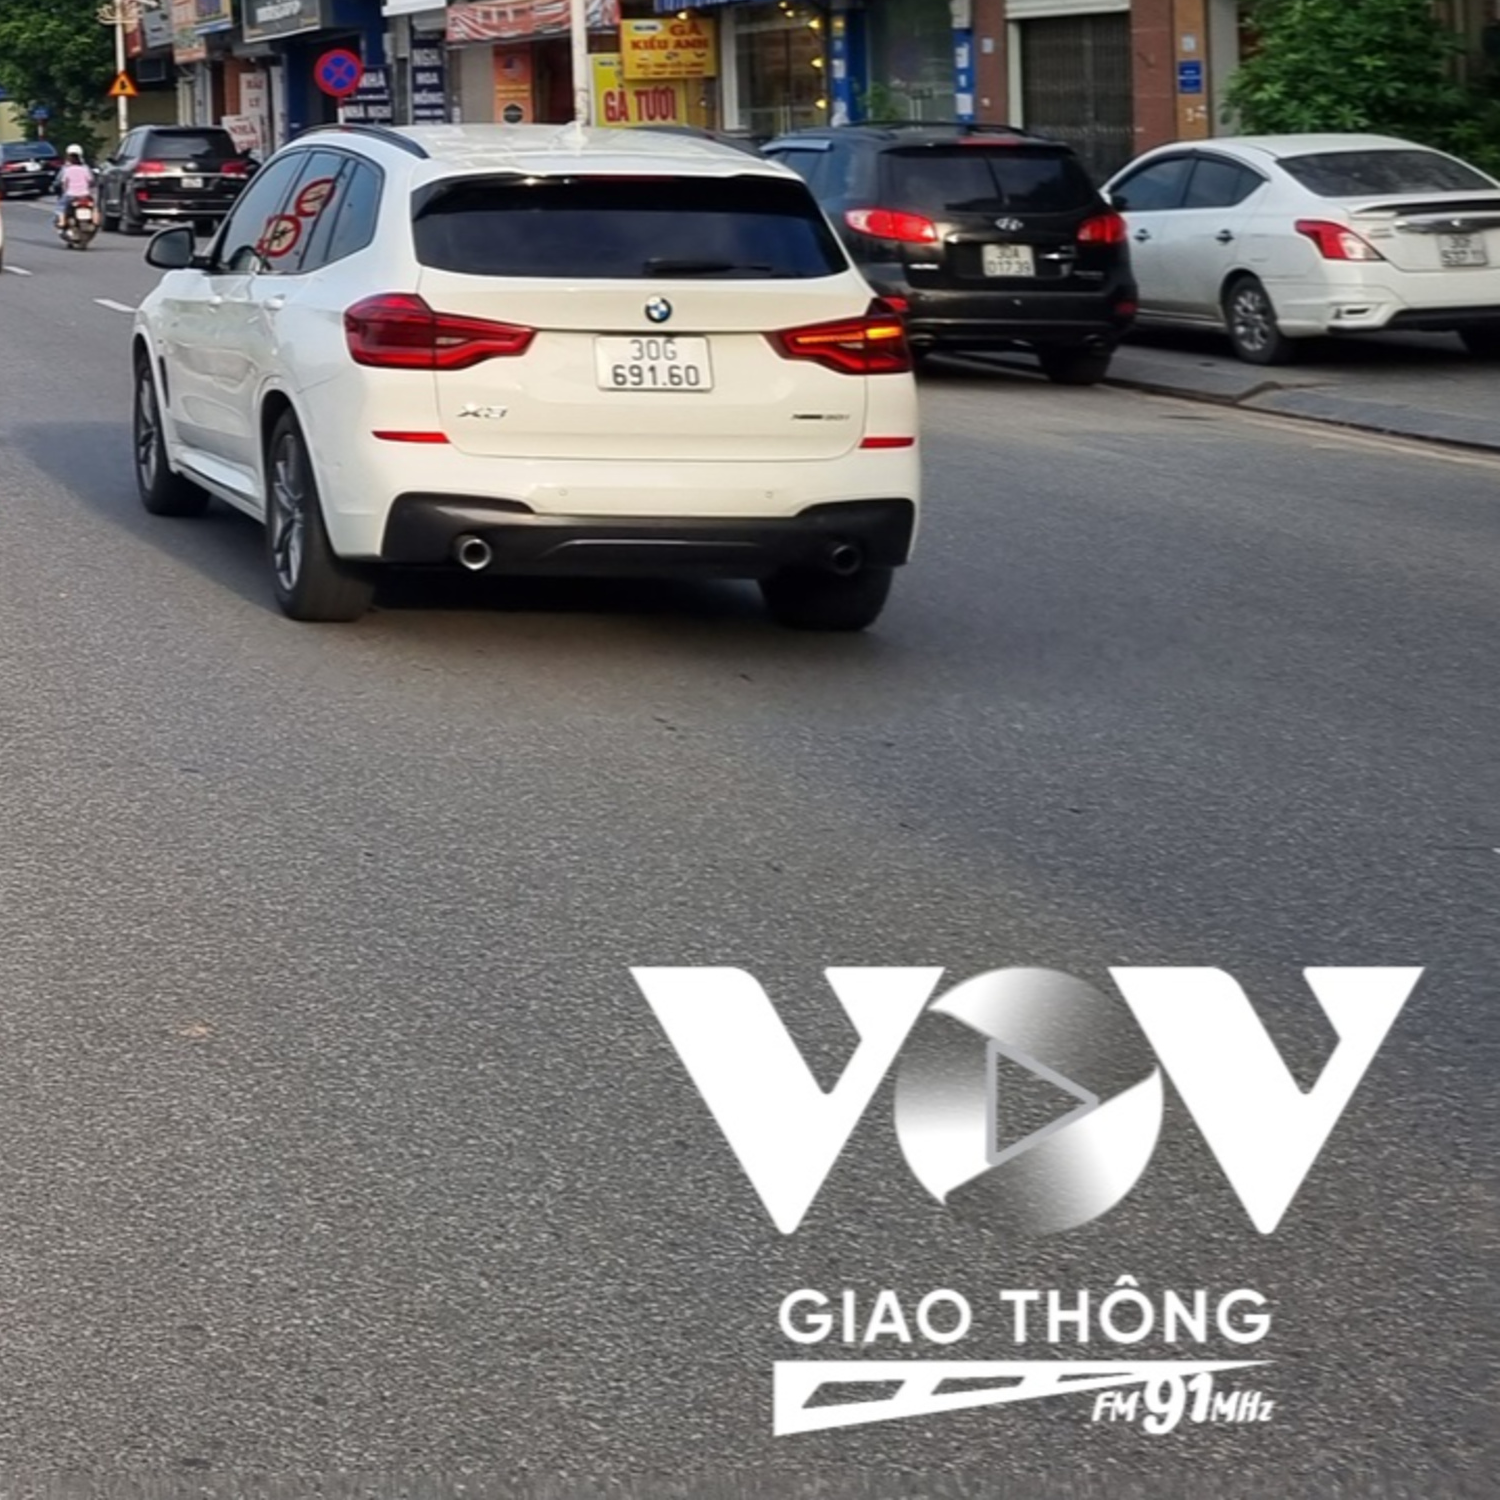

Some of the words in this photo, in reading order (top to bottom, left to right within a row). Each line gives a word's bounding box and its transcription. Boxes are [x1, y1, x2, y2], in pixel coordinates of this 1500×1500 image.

[673, 38, 709, 50] ANH
[633, 85, 678, 122] TƯƠI
[629, 338, 678, 362] 30G
[611, 363, 701, 387] 691.60
